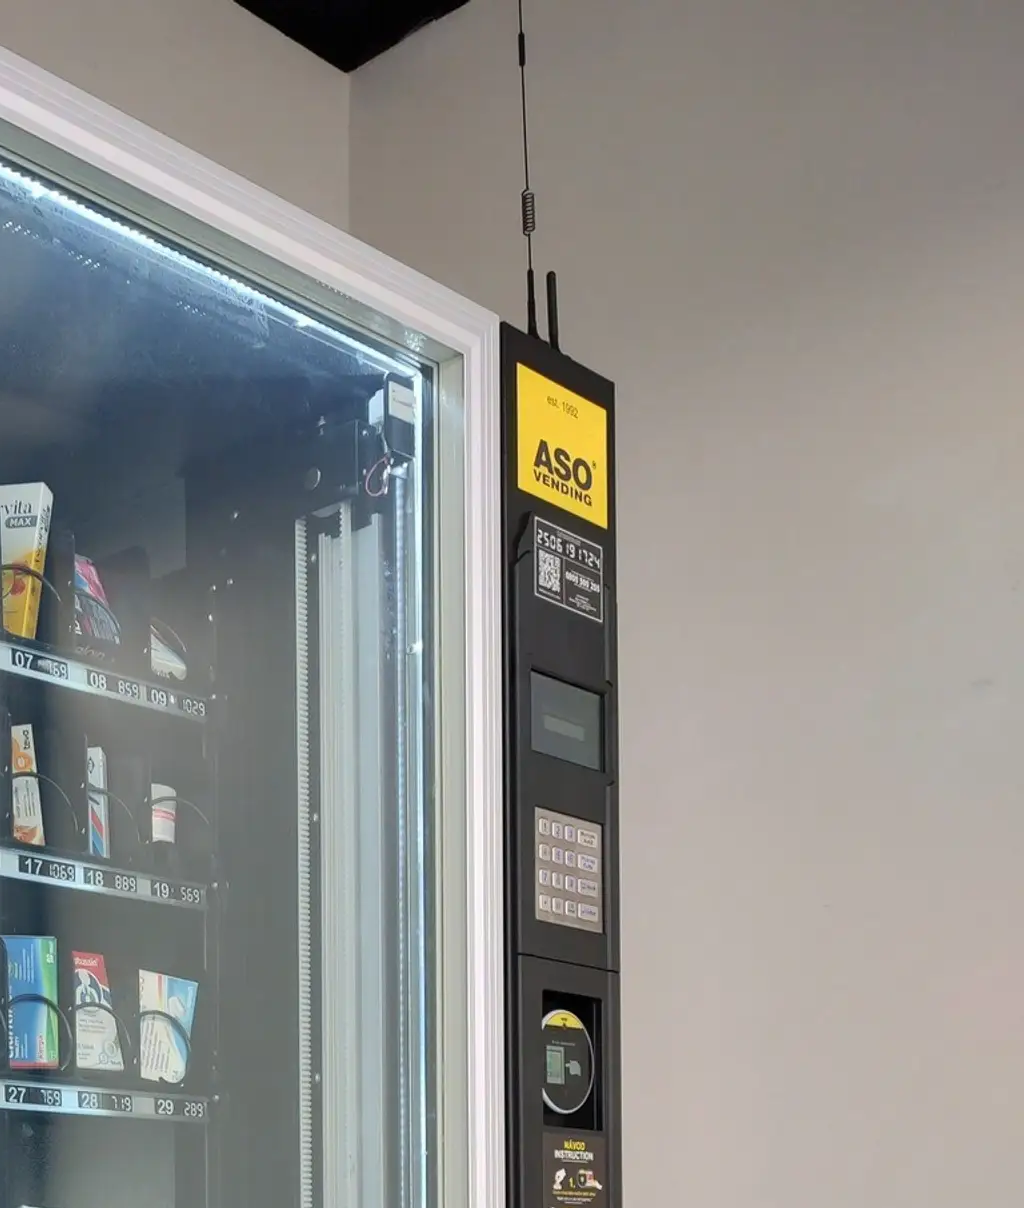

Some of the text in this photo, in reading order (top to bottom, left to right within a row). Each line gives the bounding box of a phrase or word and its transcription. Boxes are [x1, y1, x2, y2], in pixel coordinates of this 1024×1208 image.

[561, 401, 579, 419] 1992
[533, 439, 593, 491] ASO
[533, 469, 593, 507] VENDING
[9, 516, 32, 527] MAX
[537, 528, 563, 553] 2506
[15, 651, 34, 670] 07
[90, 671, 139, 699] 08 859
[151, 689, 206, 717] 09 1029
[25, 859, 75, 882] 17 1069
[87, 870, 137, 892] 18 889
[154, 882, 200, 903] 19 569
[8, 1087, 26, 1103] 27
[81, 1092, 99, 1109] 28
[157, 1099, 204, 1118] 29 289
